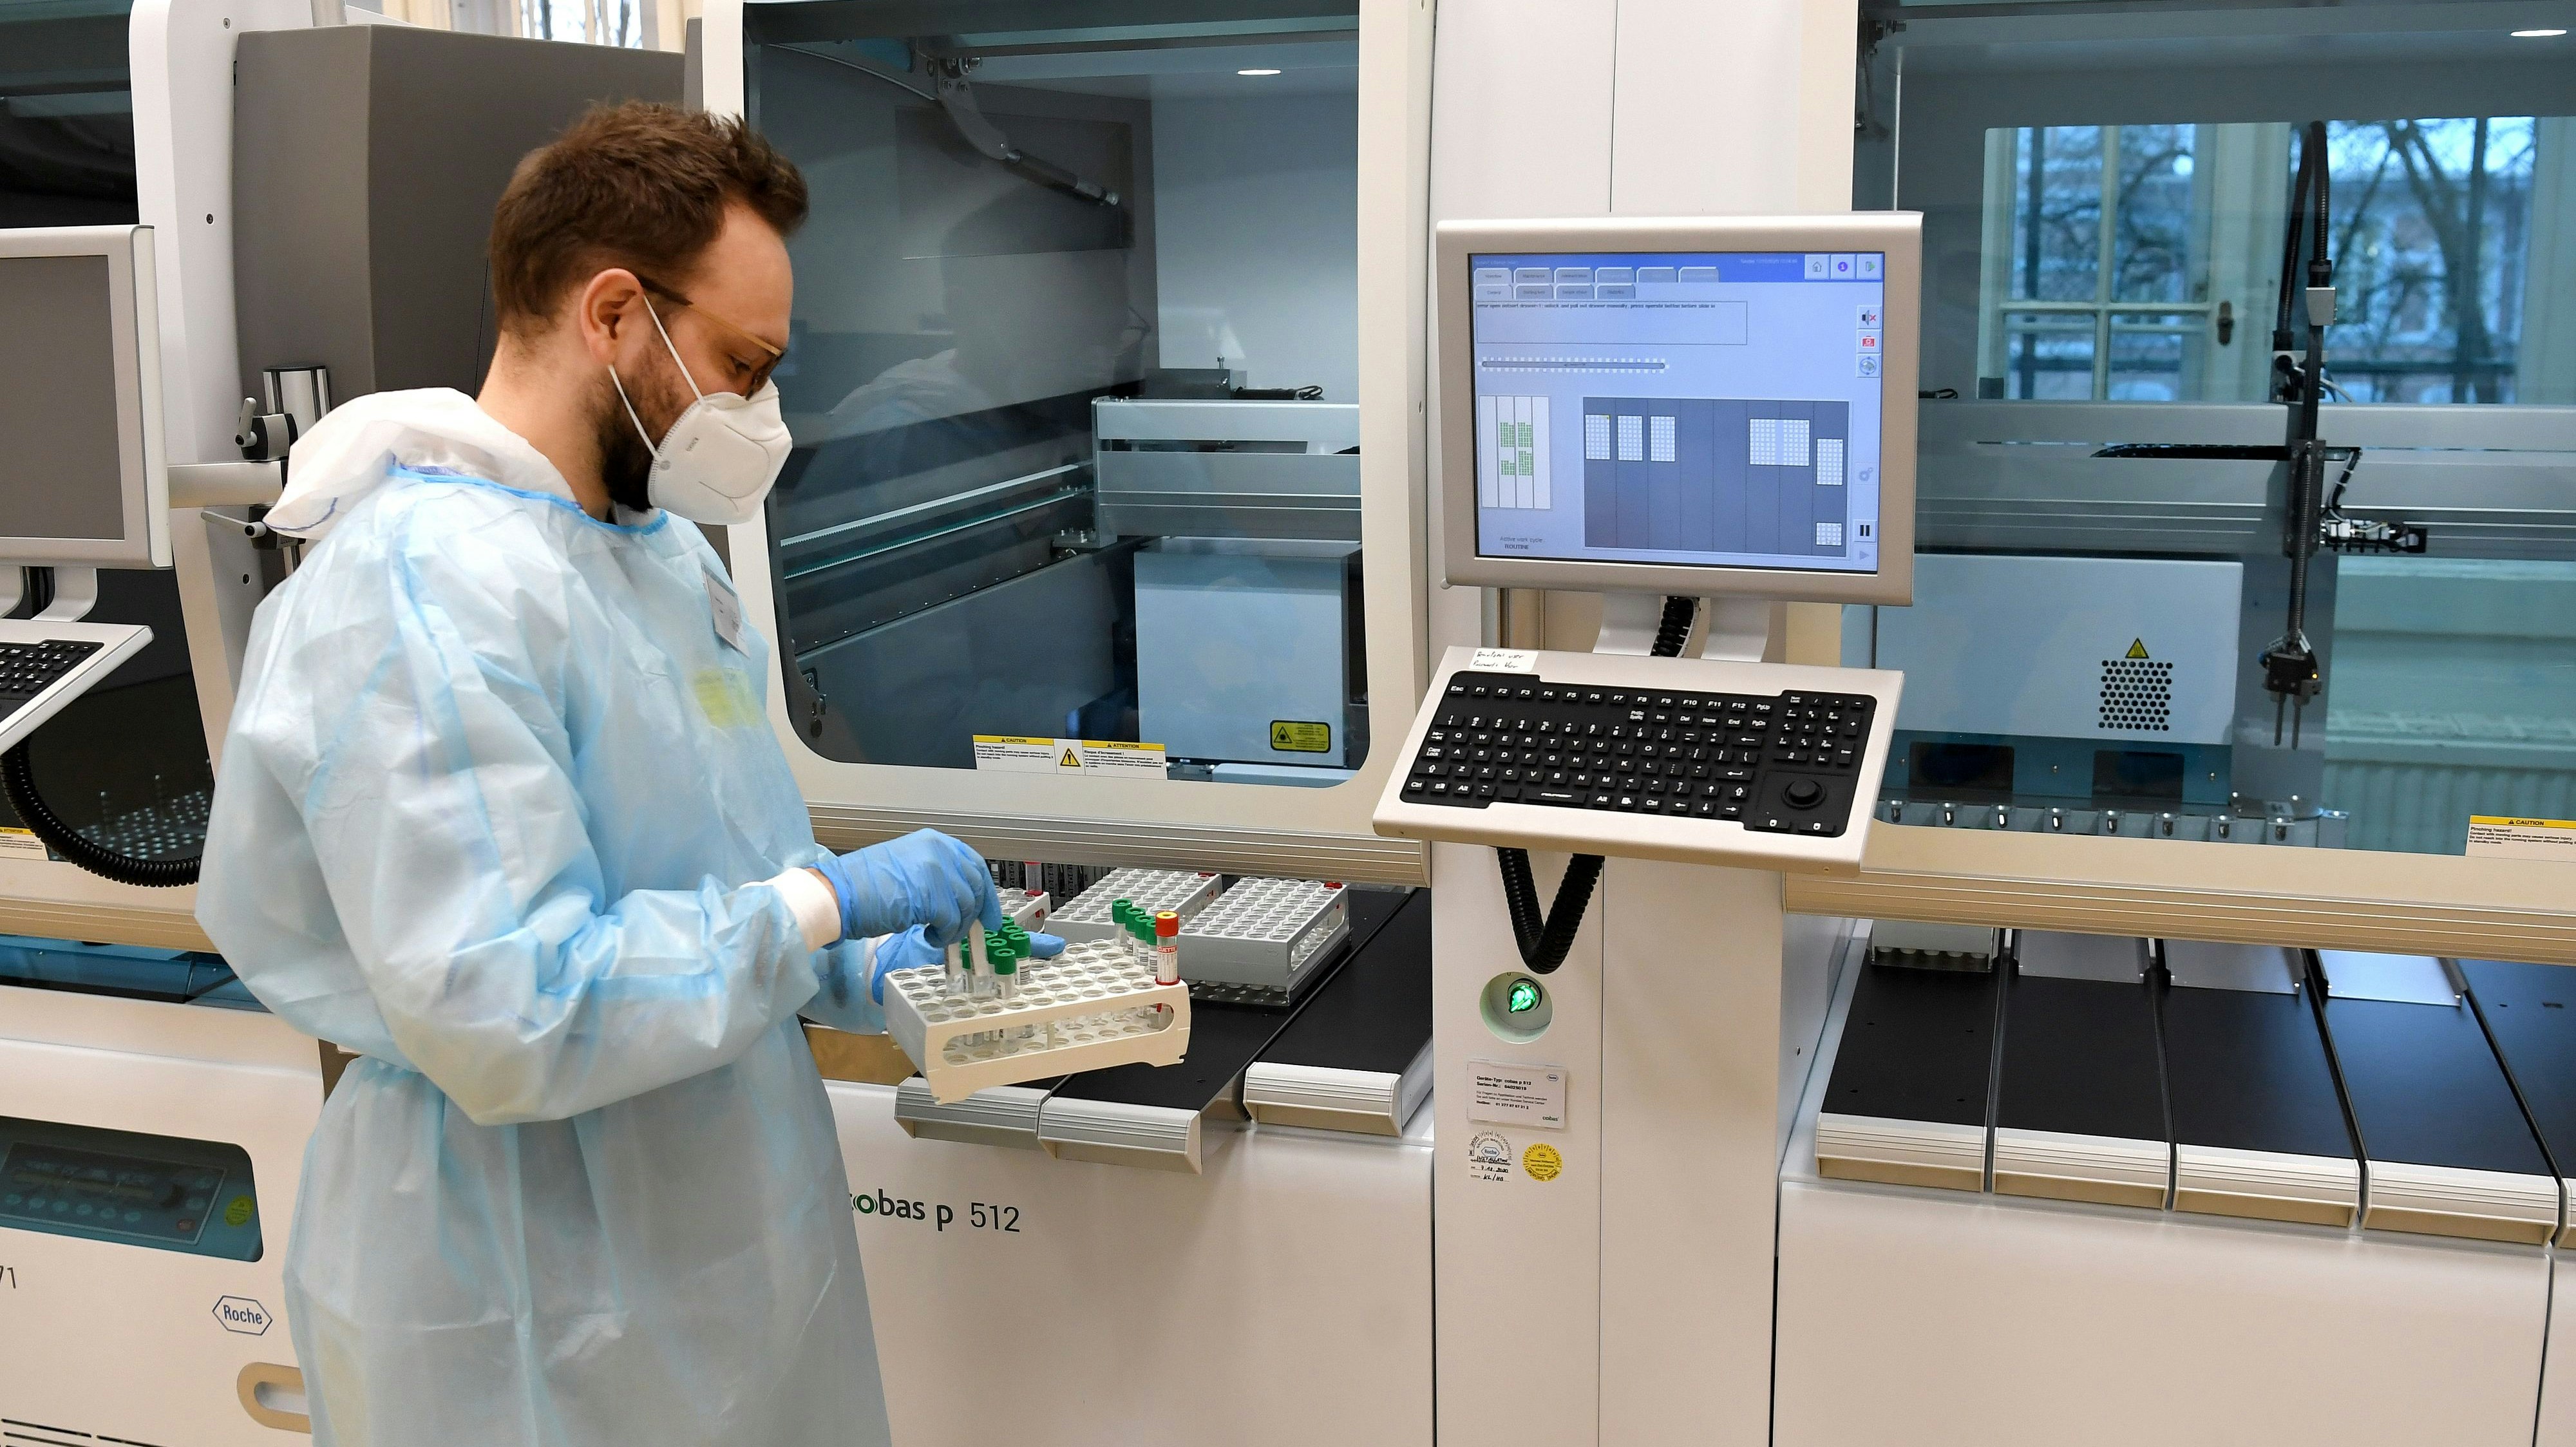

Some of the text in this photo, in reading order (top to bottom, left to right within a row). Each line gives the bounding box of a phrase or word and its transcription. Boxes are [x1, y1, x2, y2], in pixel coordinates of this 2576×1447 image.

[936, 1204, 953, 1232] p
[970, 1202, 1020, 1233] 512
[223, 1304, 263, 1325] Roche
